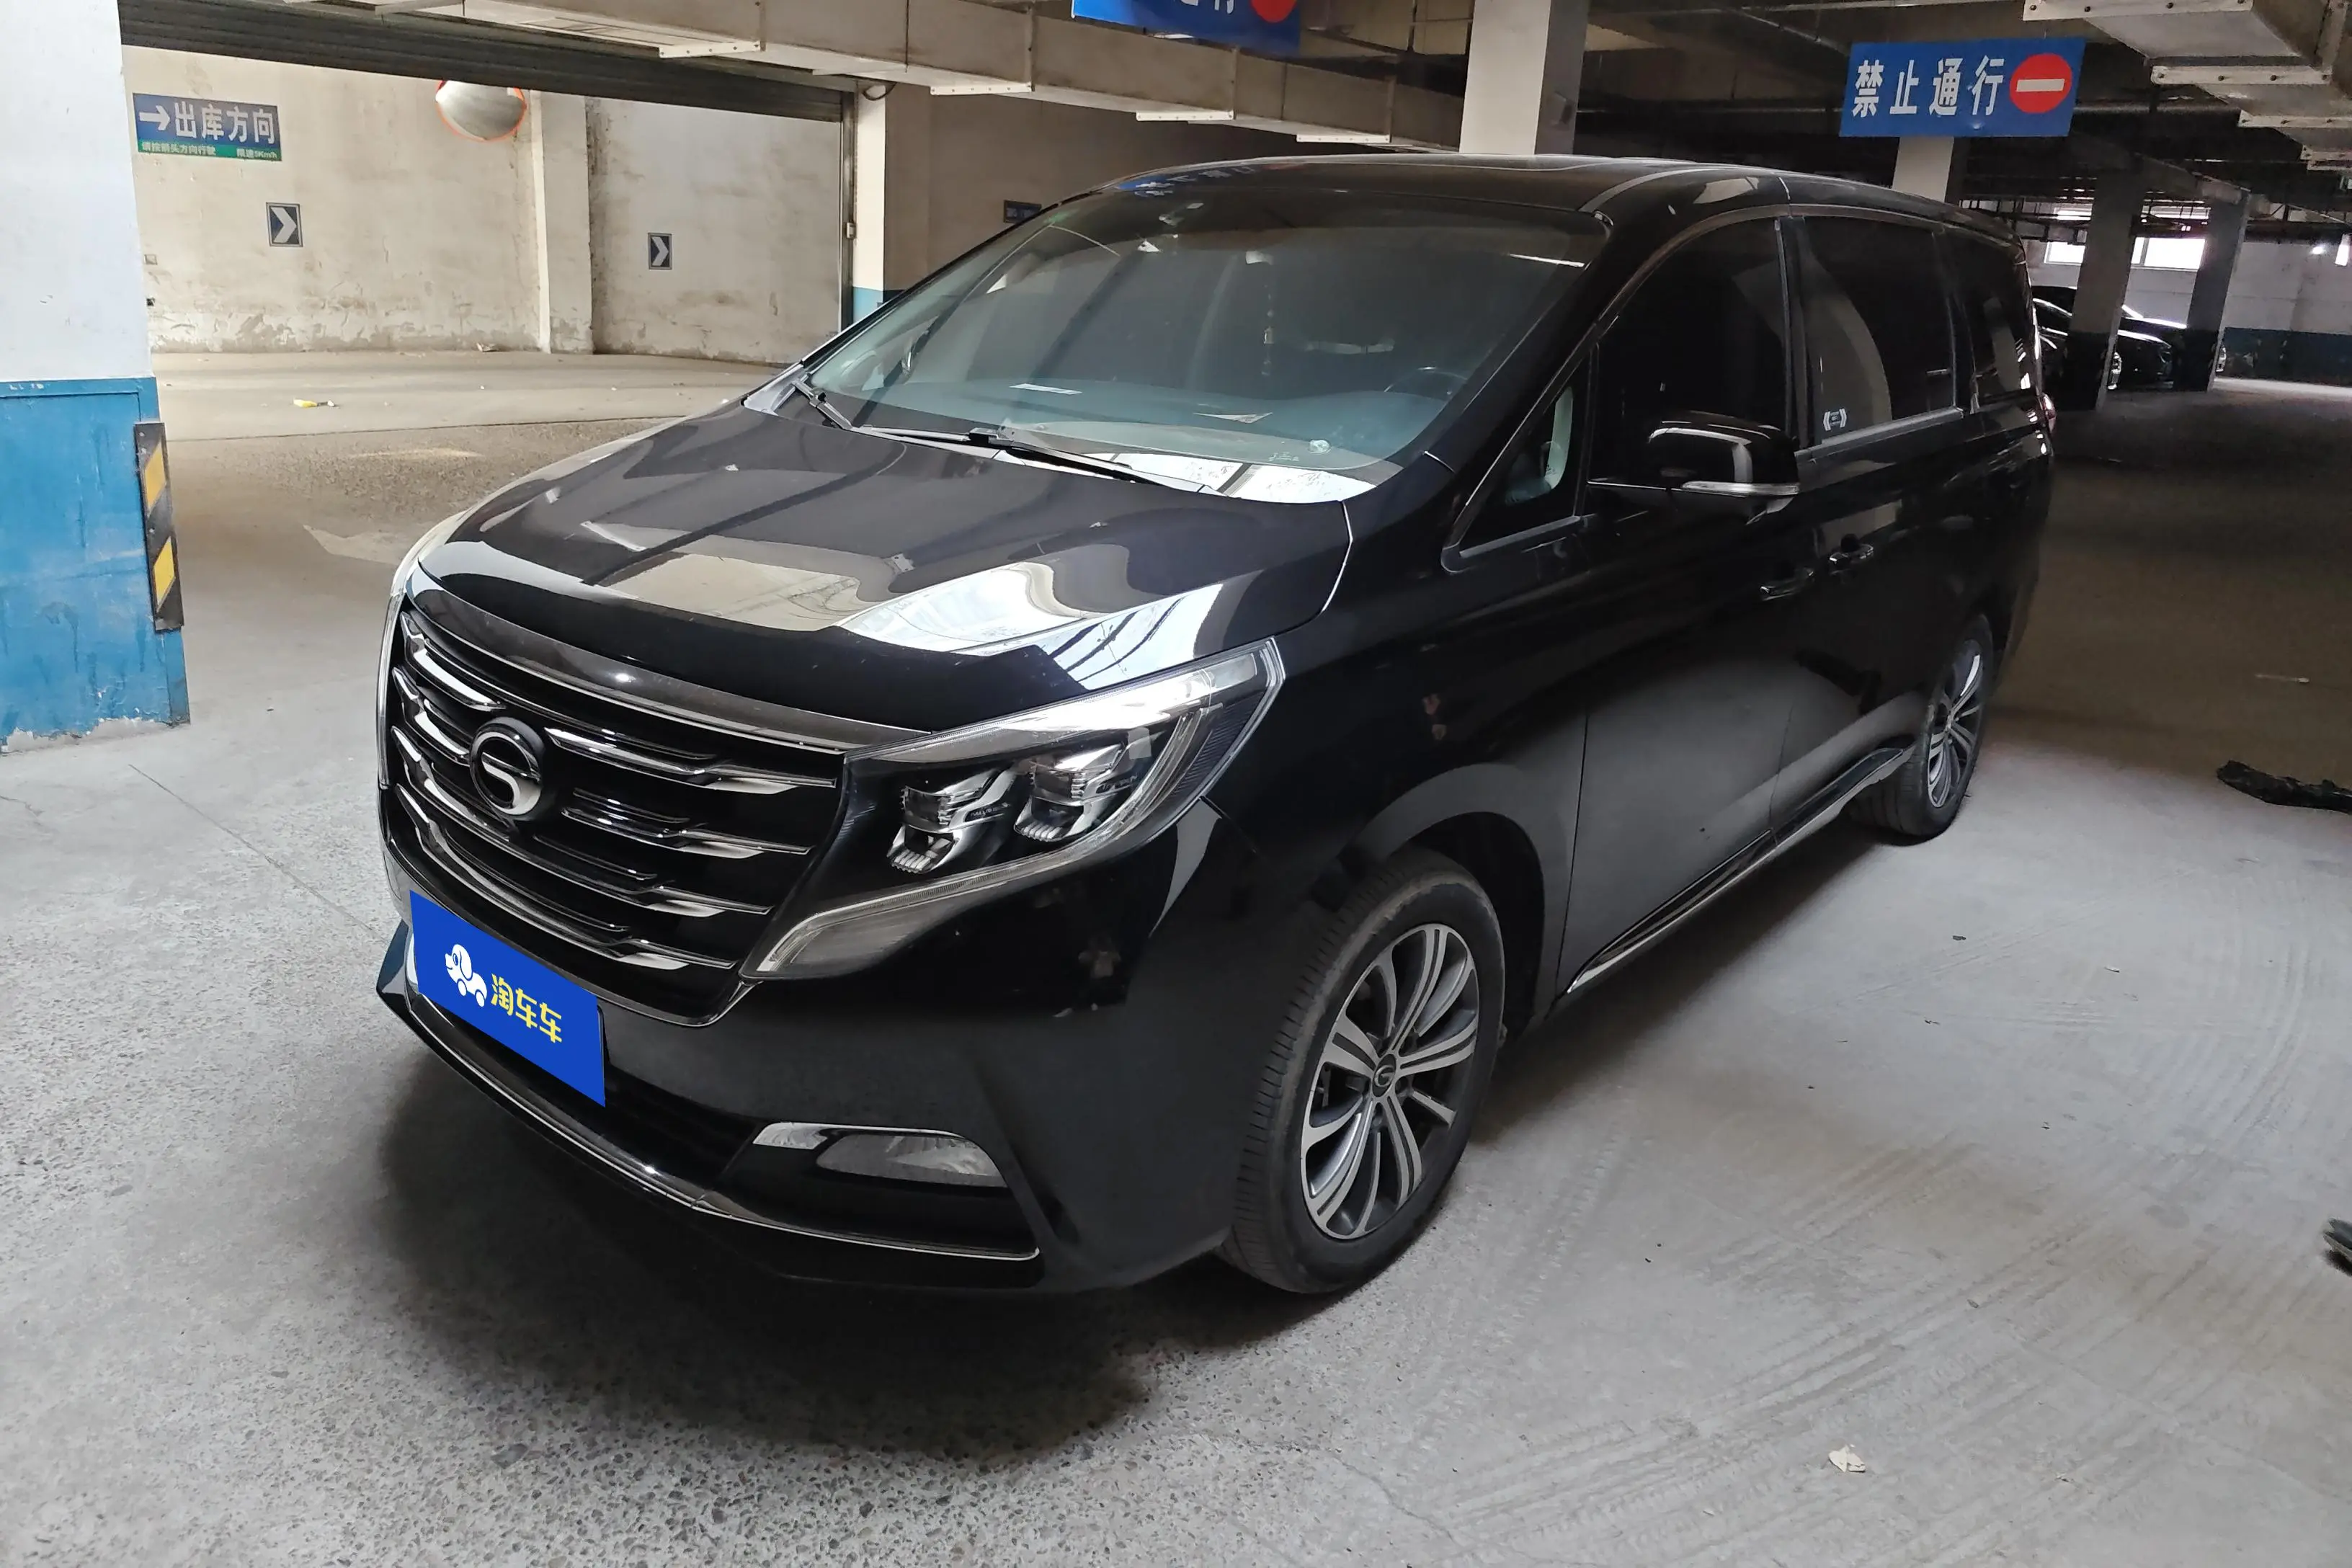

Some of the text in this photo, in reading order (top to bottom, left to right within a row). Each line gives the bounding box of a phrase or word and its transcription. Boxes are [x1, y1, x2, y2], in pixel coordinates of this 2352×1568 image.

[1852, 55, 2005, 117] 禁止通行
[175, 101, 275, 143] 出库方向
